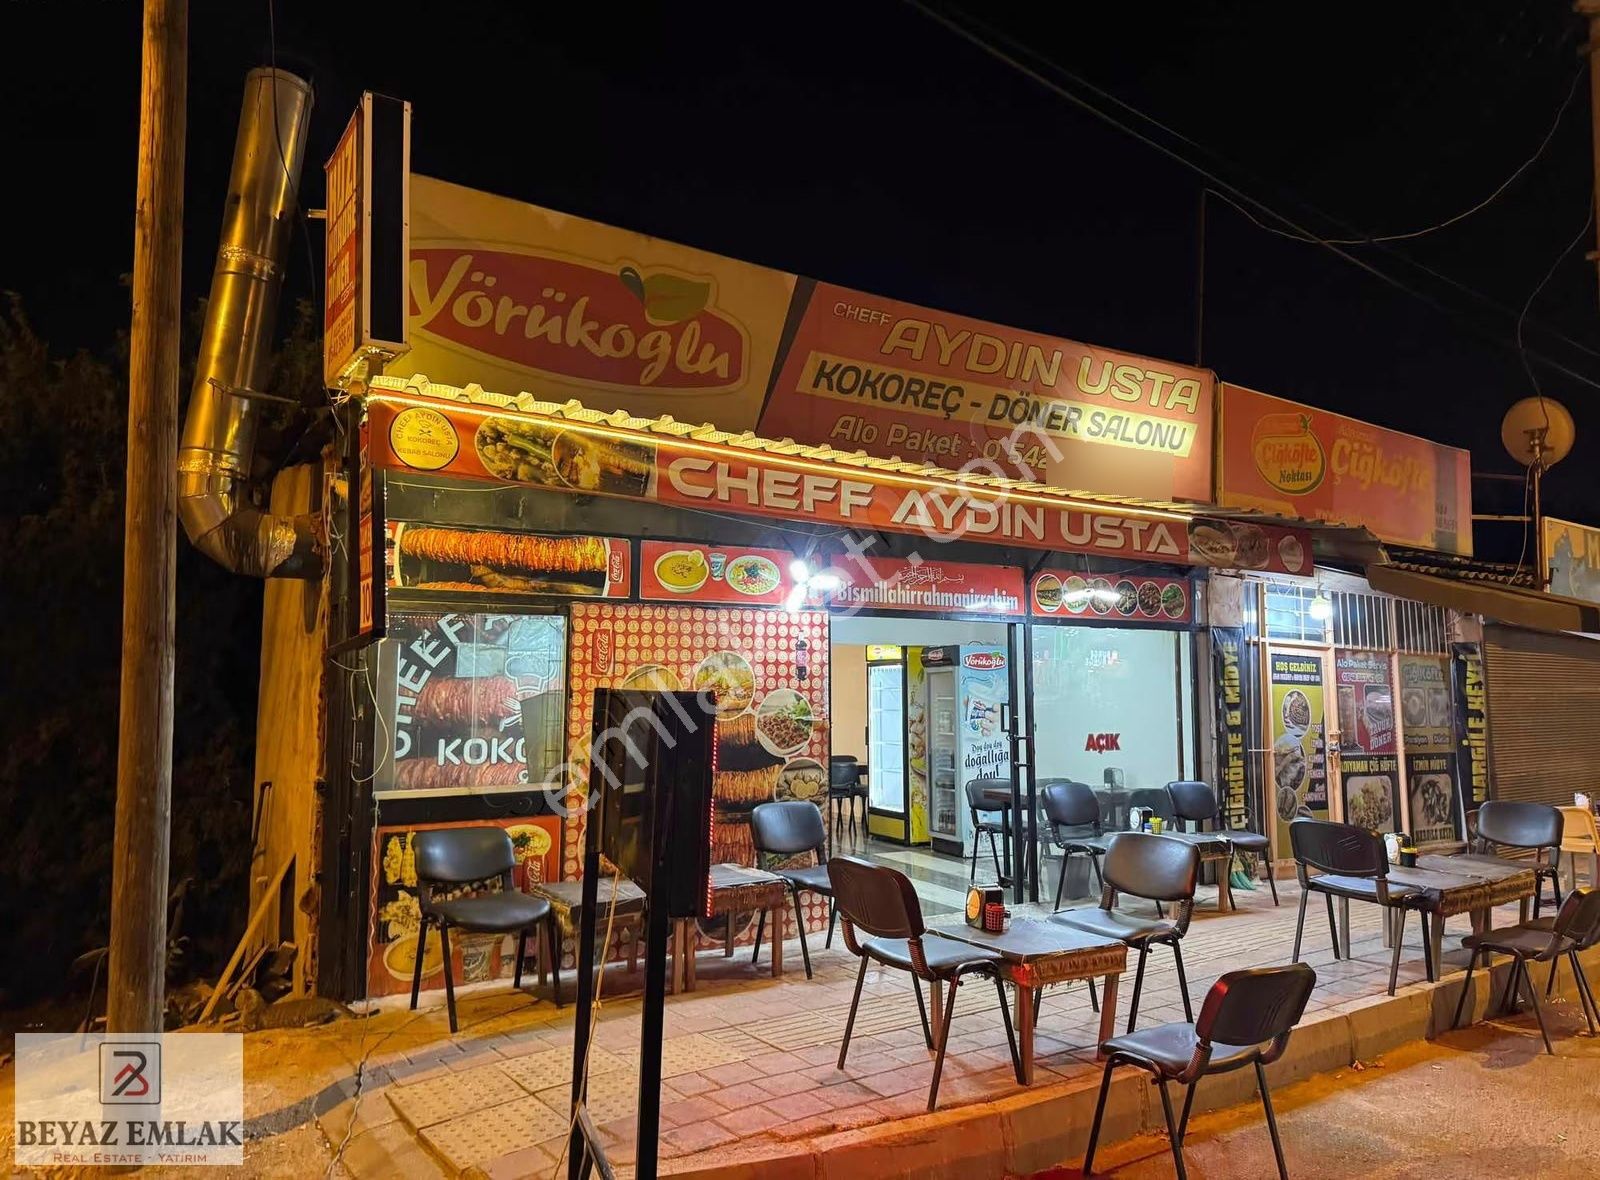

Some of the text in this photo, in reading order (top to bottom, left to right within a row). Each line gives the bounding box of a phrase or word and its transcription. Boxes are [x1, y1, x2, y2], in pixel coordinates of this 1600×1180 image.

[833, 302, 1202, 415] CHEFF AYDIN USTA
[812, 358, 965, 421] KOKOREÇ
[987, 389, 1083, 434] DÖNER
[1086, 409, 1188, 451] SALONU
[829, 414, 880, 444] Alo
[886, 423, 962, 457] Paket
[668, 457, 1181, 556] CHEFF AYDIN USTA
[1219, 640, 1241, 704] MİDYE
[964, 747, 1010, 769] doğallığa
[1085, 732, 1121, 755] AÇIK
[1462, 716, 1487, 803] NARGİLE
